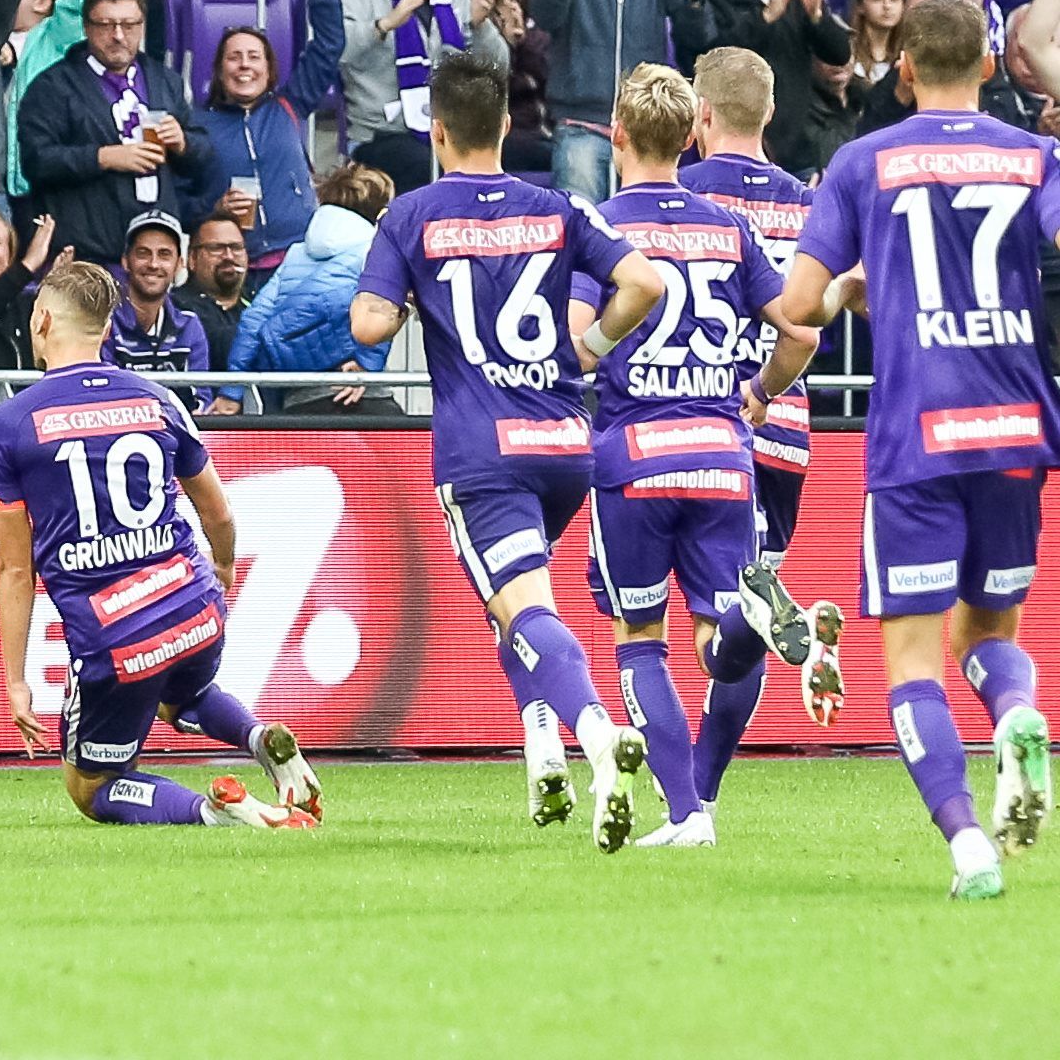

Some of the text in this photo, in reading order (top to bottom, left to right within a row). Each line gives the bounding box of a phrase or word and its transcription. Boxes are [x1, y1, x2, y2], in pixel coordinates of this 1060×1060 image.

[919, 152, 1034, 175] GENERALI
[461, 223, 559, 248] GENERALI
[651, 229, 737, 253] GENERALI
[891, 184, 1031, 310] 17
[436, 252, 558, 365] 16
[627, 259, 739, 366] 25
[916, 309, 1035, 348] KLEIN
[932, 415, 1039, 442] wienholding
[54, 433, 166, 538] 10
[894, 565, 954, 588] Verbund
[123, 617, 219, 674] wienholding
